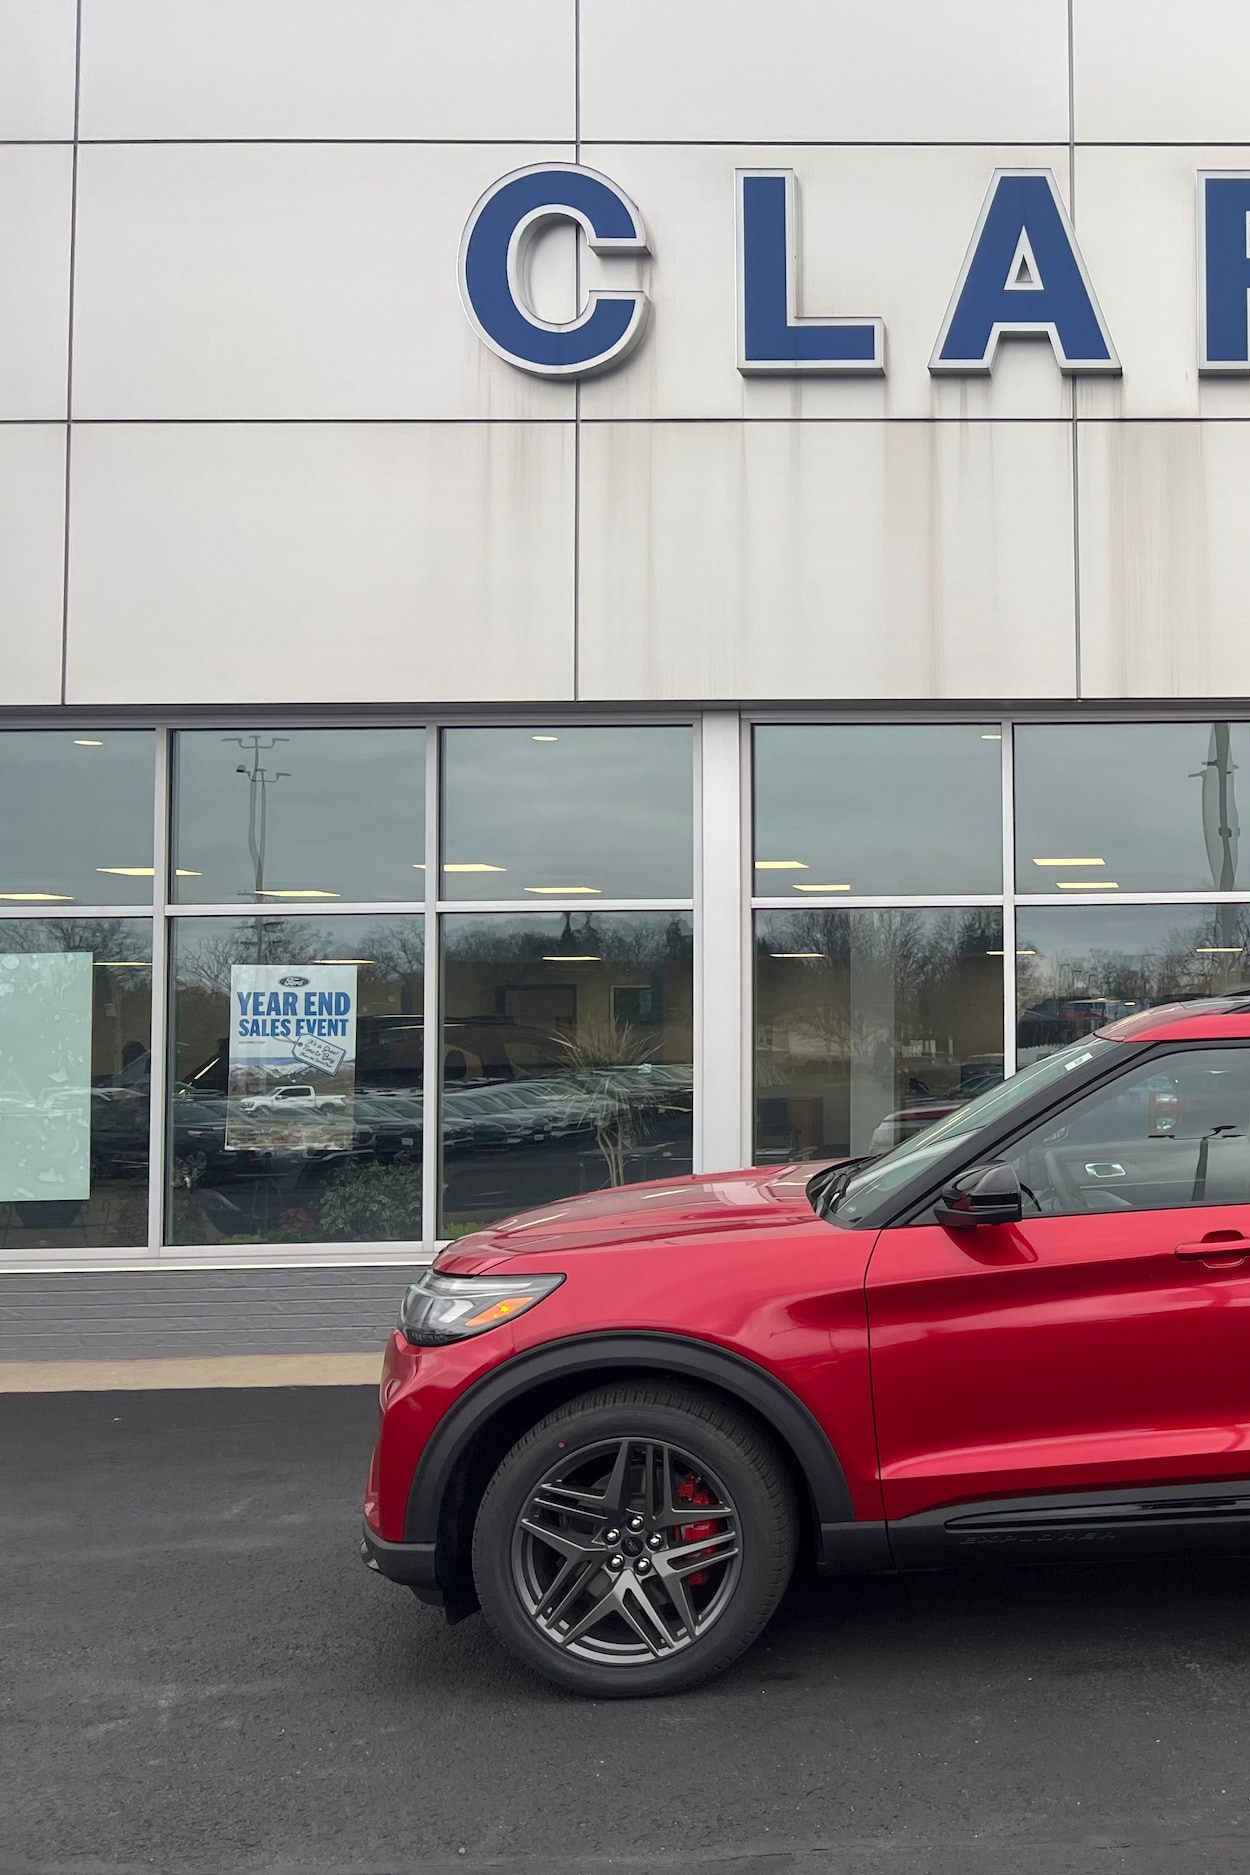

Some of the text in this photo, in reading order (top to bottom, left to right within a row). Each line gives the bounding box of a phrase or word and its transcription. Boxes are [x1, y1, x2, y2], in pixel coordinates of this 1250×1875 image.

[237, 992, 351, 1016] YEAR END
[238, 1018, 349, 1037] SALES EVENT
